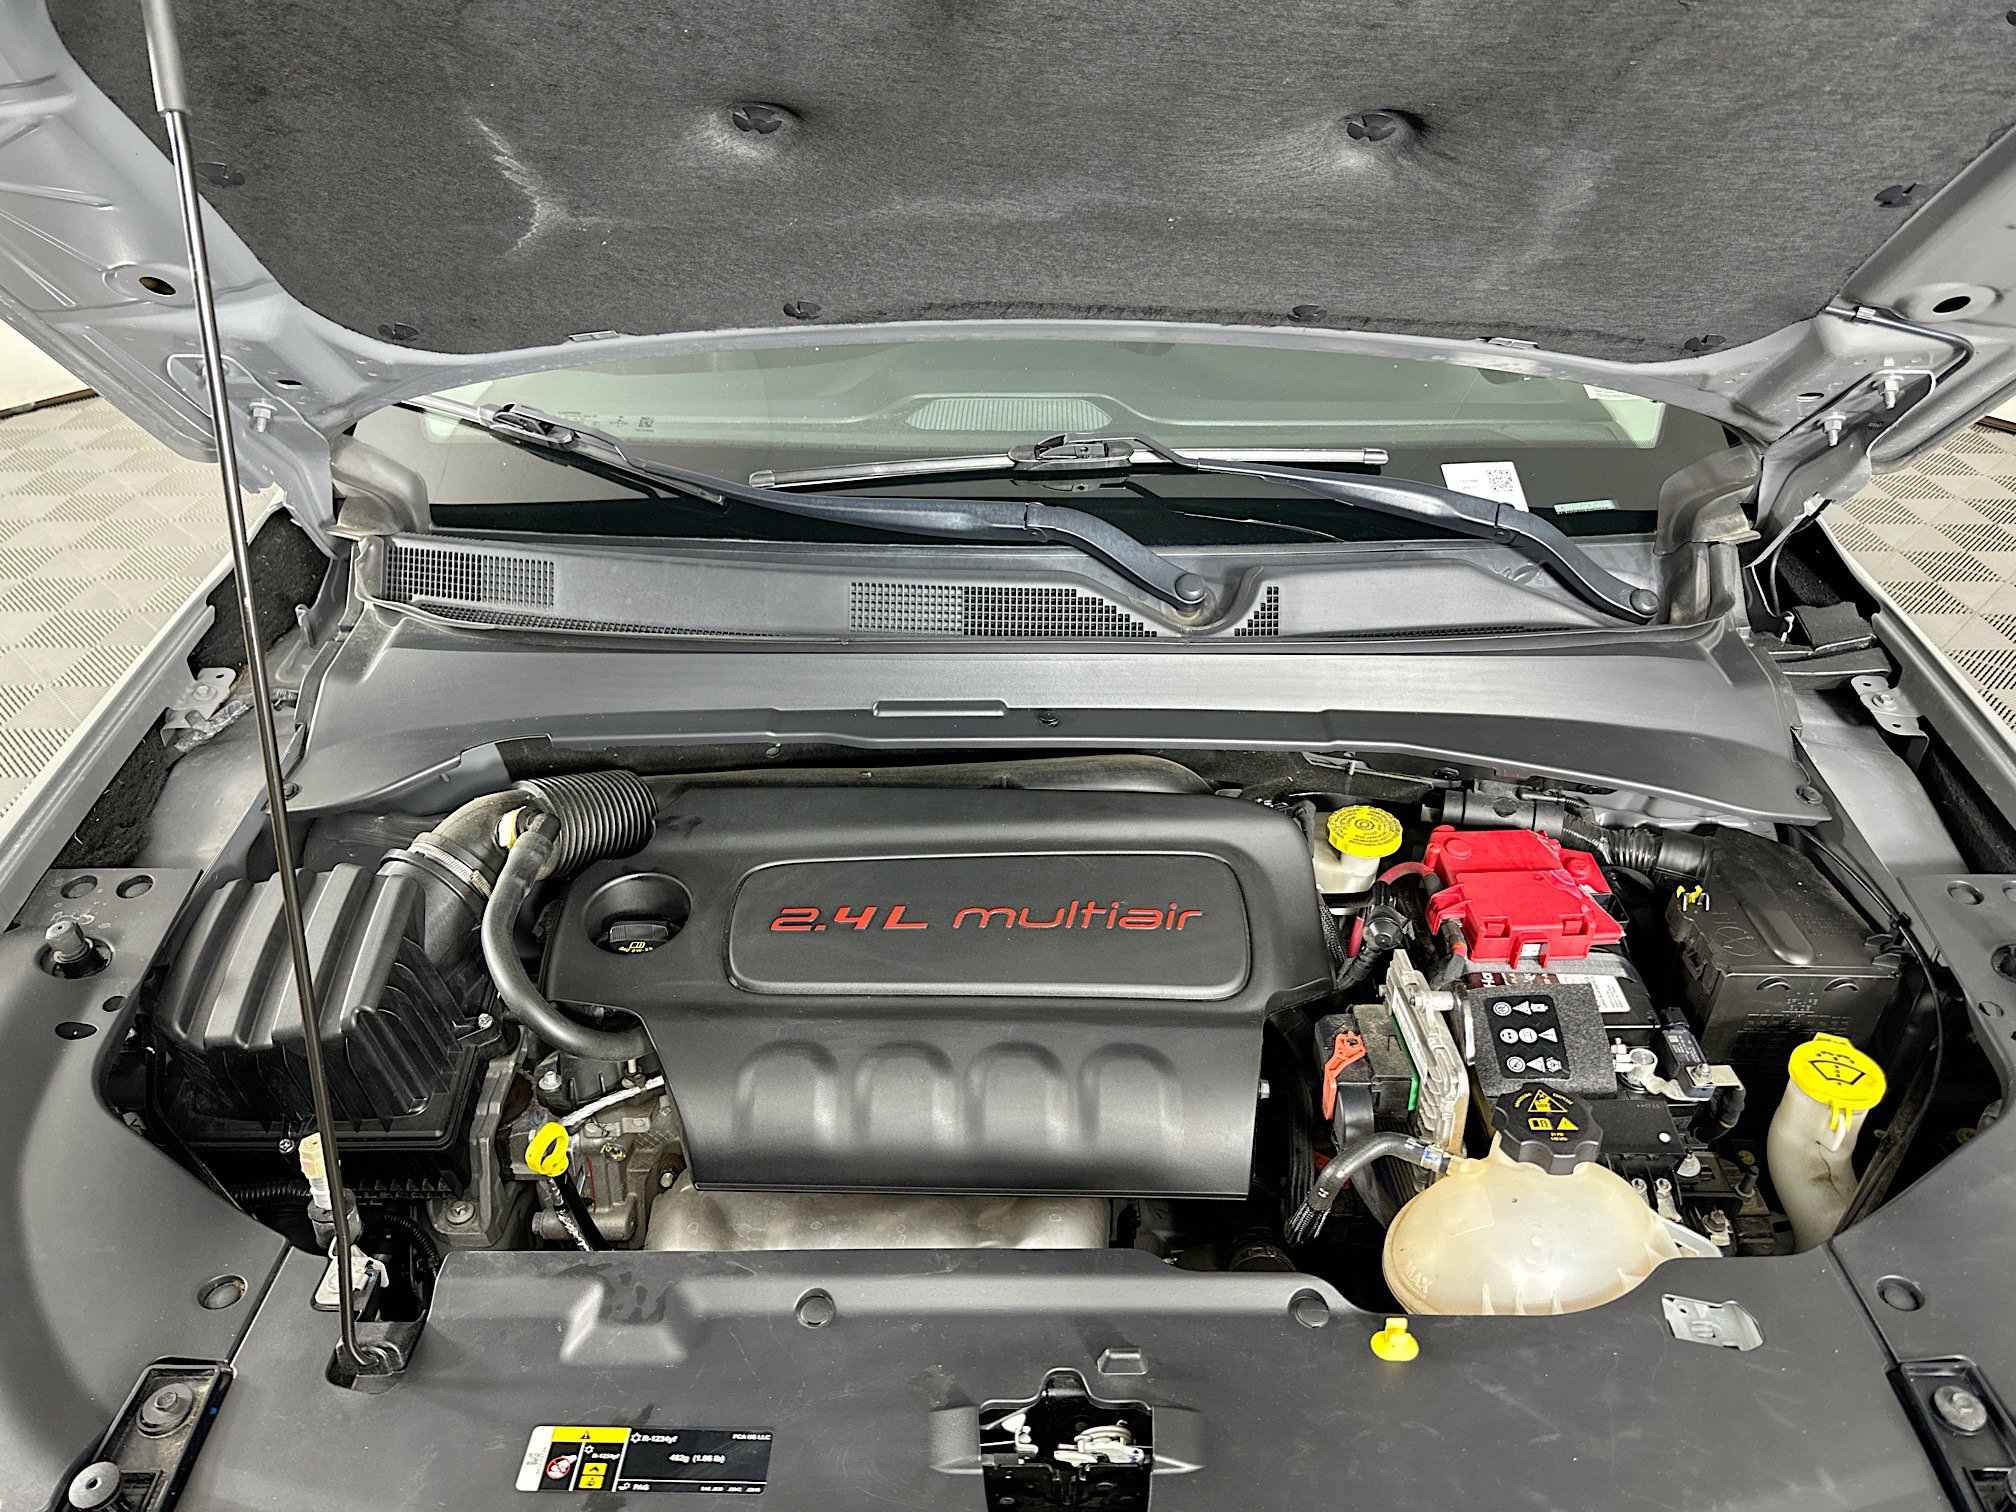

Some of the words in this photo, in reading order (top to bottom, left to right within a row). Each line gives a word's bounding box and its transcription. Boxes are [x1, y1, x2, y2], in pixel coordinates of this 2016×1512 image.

[770, 905, 929, 932] 2.4L
[951, 900, 1204, 931] multiair
[641, 1434, 679, 1445] R-1234yf
